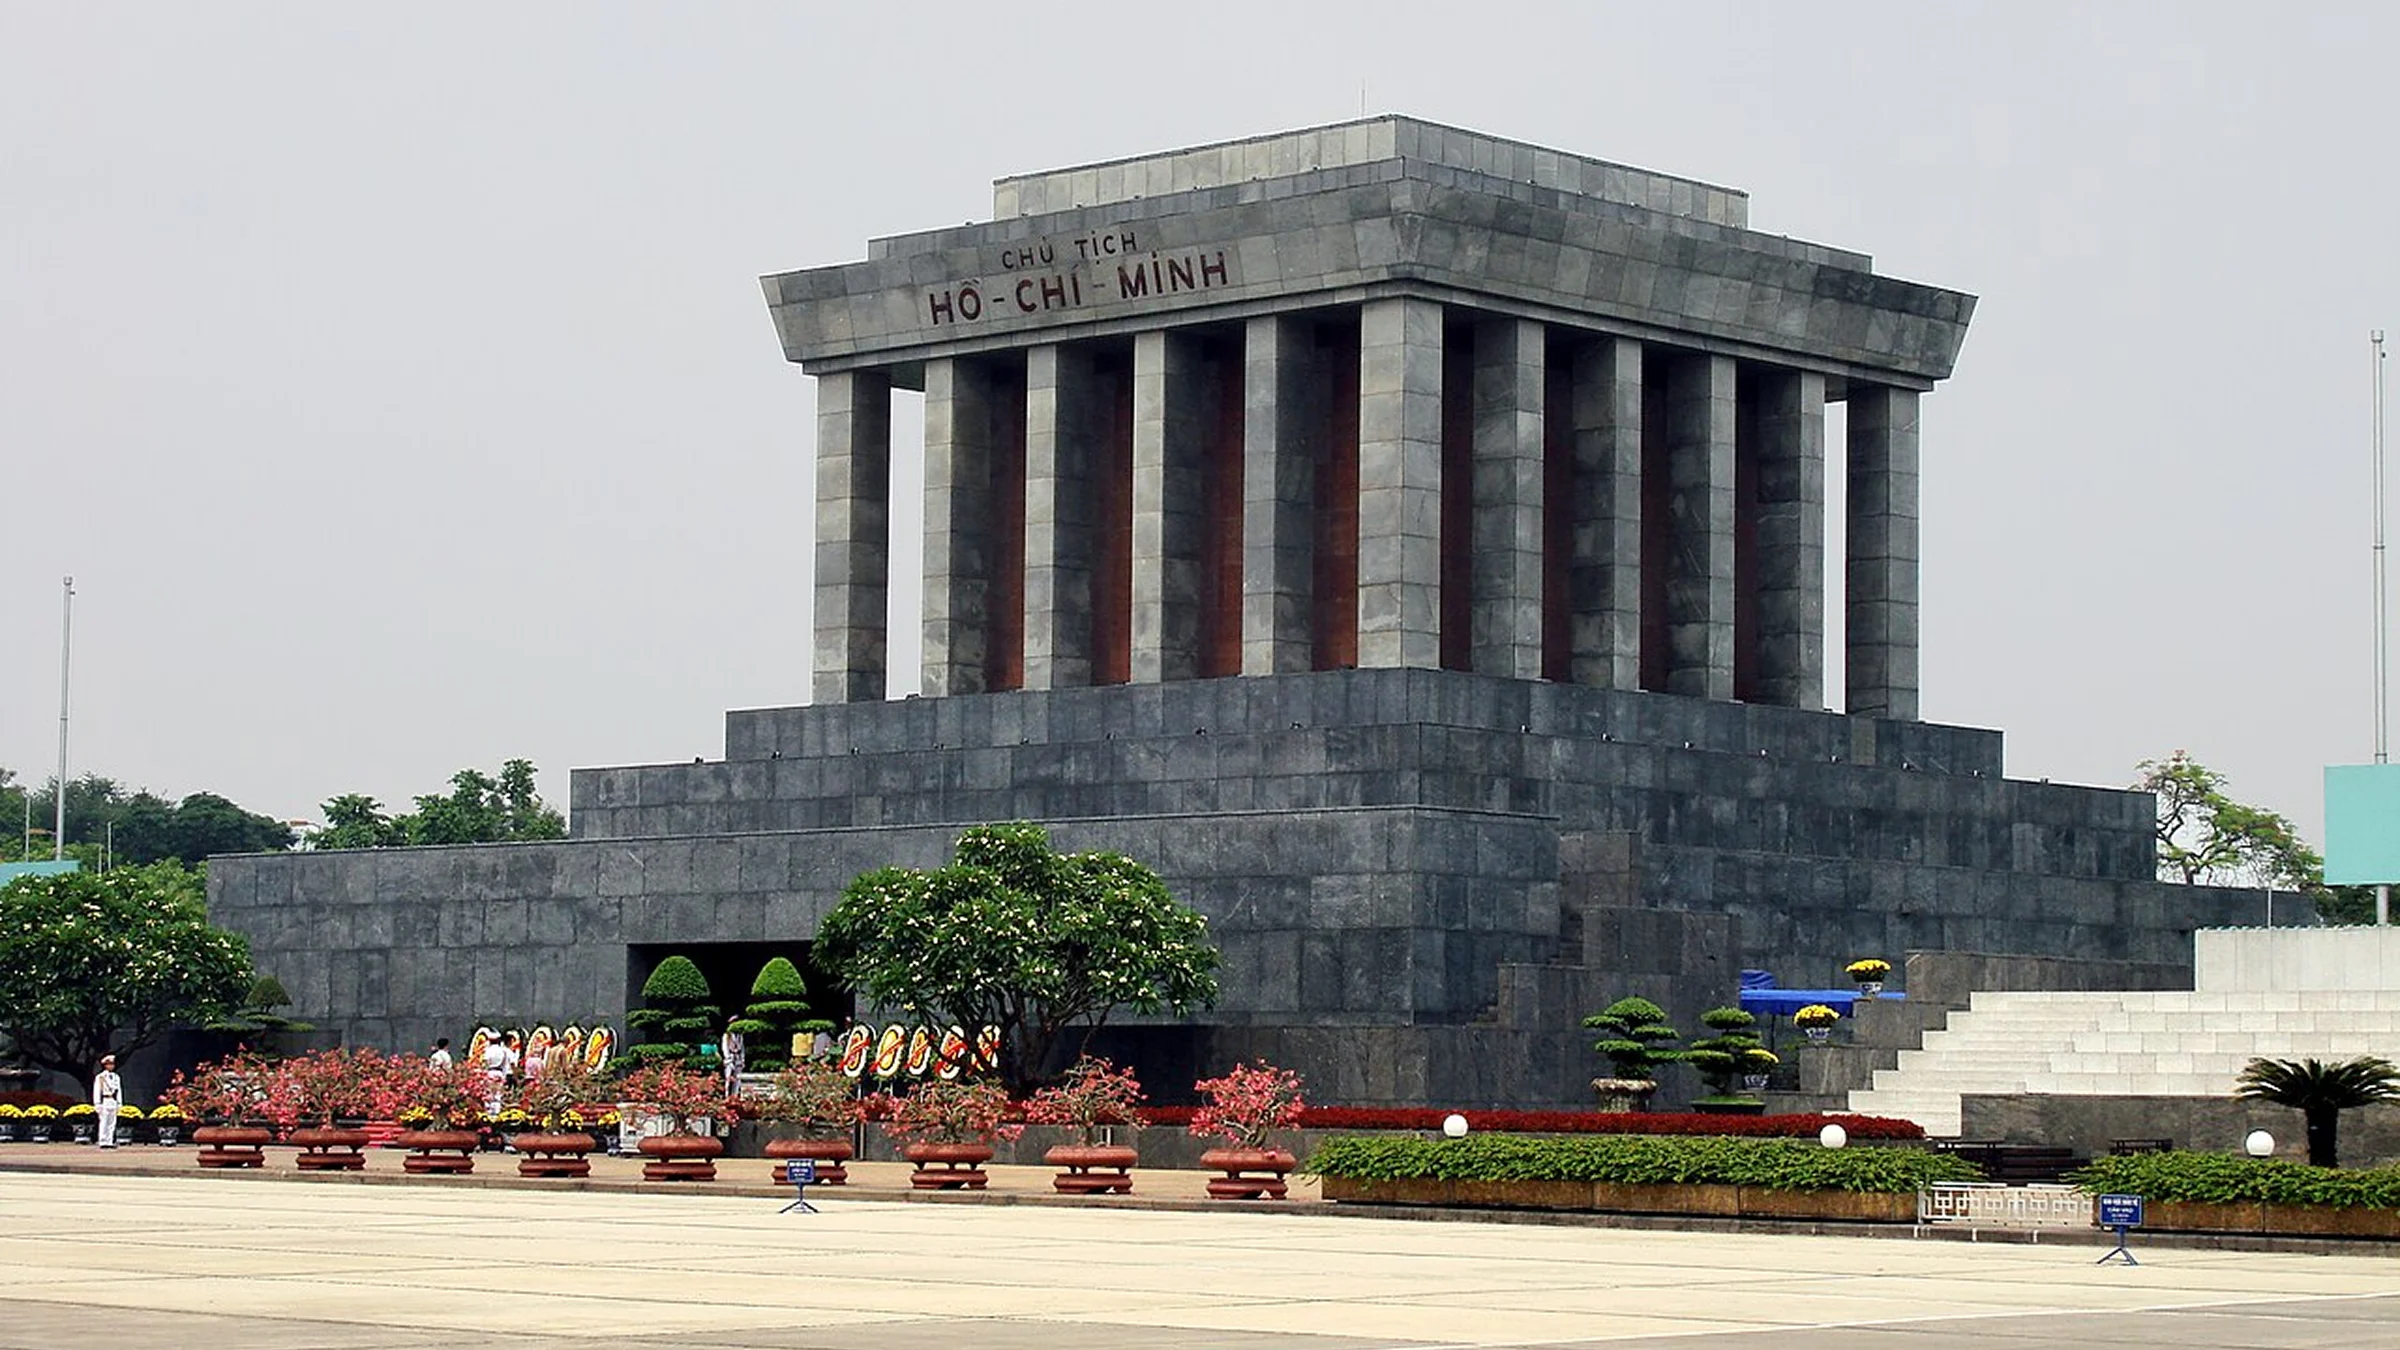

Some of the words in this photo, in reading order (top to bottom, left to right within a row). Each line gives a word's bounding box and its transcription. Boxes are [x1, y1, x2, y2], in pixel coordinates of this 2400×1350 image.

[1002, 235, 1054, 269] CHỦ
[1074, 230, 1137, 265] TỊCH
[929, 279, 981, 325] HỒ
[1016, 263, 1081, 313] CHÍ
